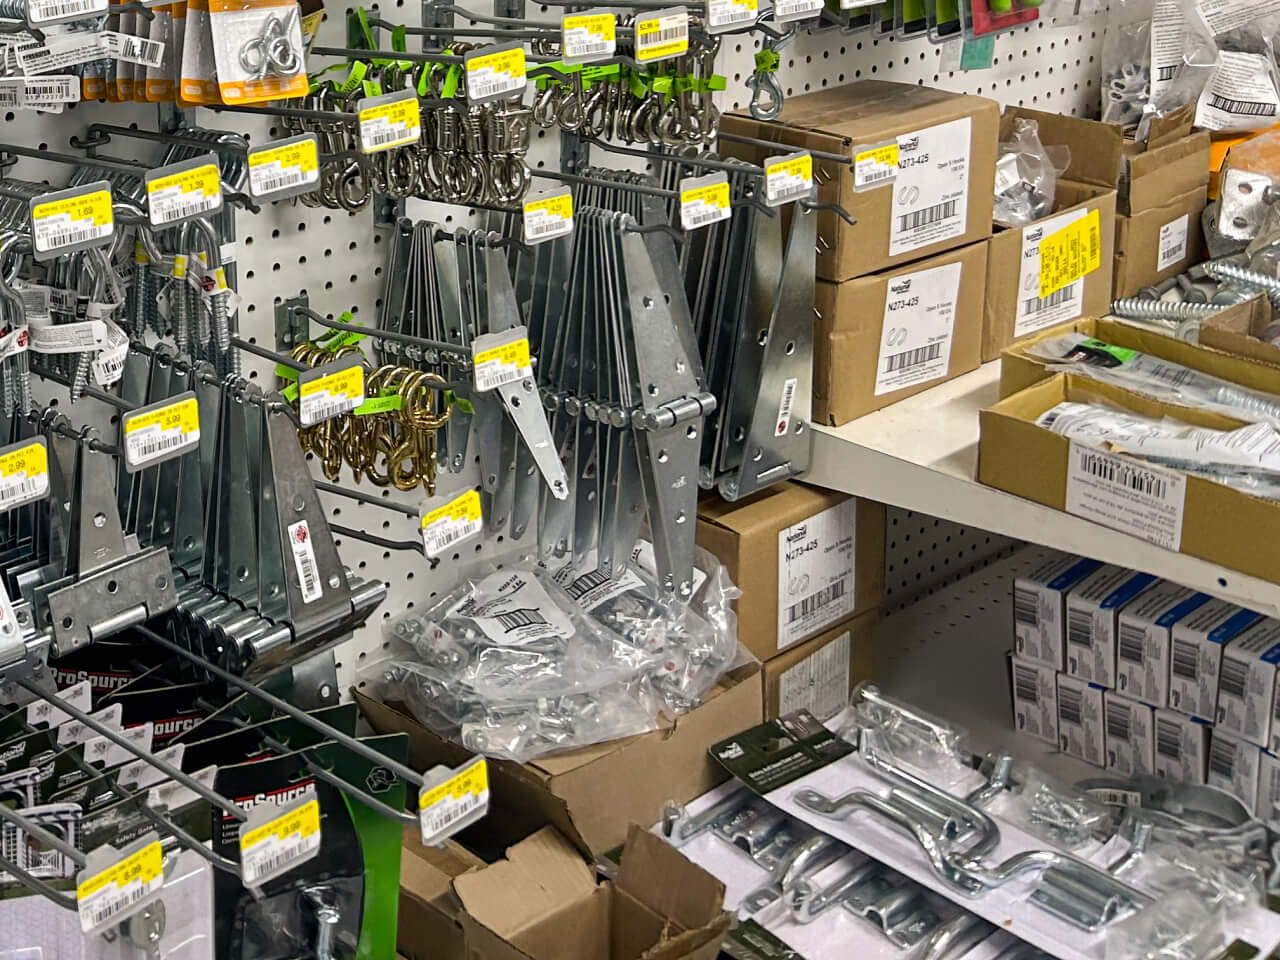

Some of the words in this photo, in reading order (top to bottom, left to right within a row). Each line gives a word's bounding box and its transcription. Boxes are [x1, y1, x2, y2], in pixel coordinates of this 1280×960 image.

[189, 179, 204, 190] 1.39
[77, 206, 93, 216] 1.69
[888, 296, 919, 312] N273-425
[9, 461, 26, 472] 2.99
[785, 539, 818, 563] N273-425
